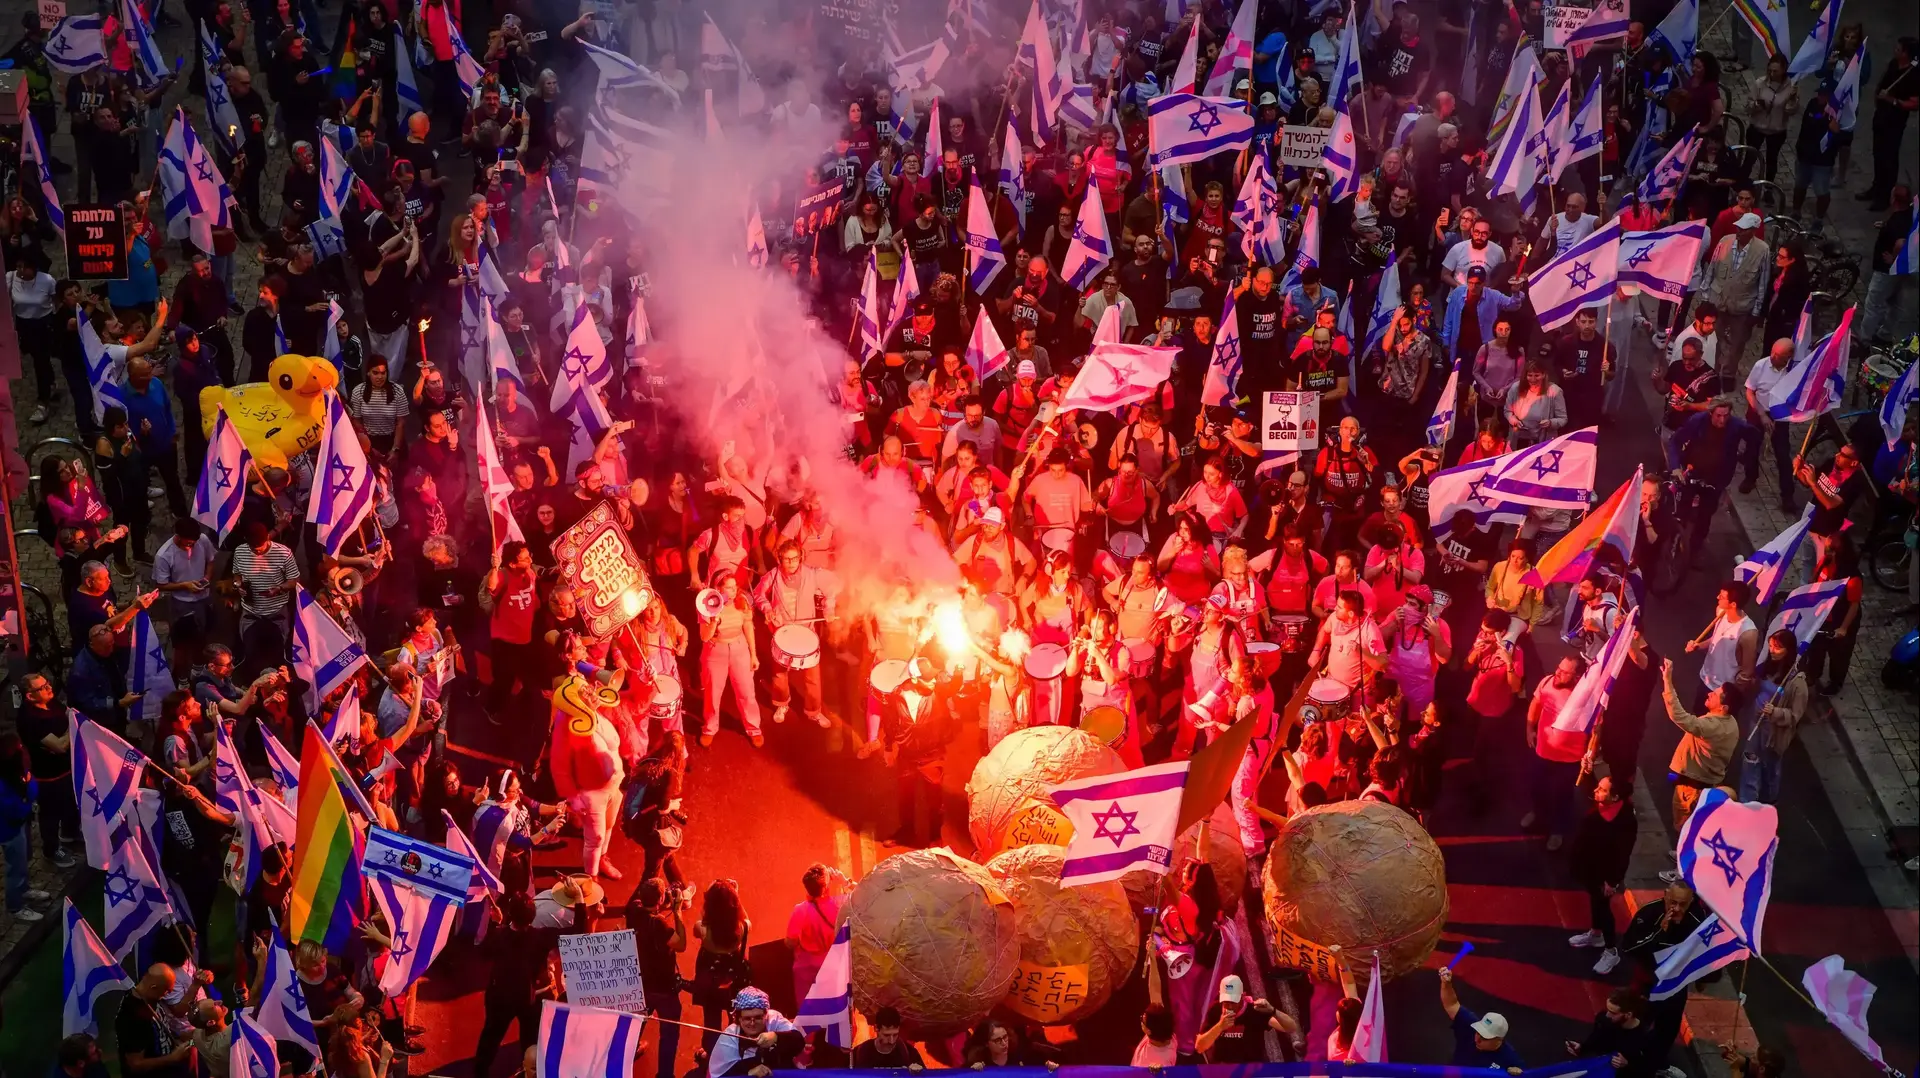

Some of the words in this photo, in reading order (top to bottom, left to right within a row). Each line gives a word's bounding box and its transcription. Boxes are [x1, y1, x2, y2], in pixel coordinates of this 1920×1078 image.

[44, 4, 59, 14] NO
[72, 209, 116, 223] מלחמה
[86, 226, 104, 240] על
[1269, 431, 1297, 440] BEGIN
[583, 535, 615, 568] מצילים
[598, 552, 612, 569] את
[597, 568, 631, 604] קרטיה
